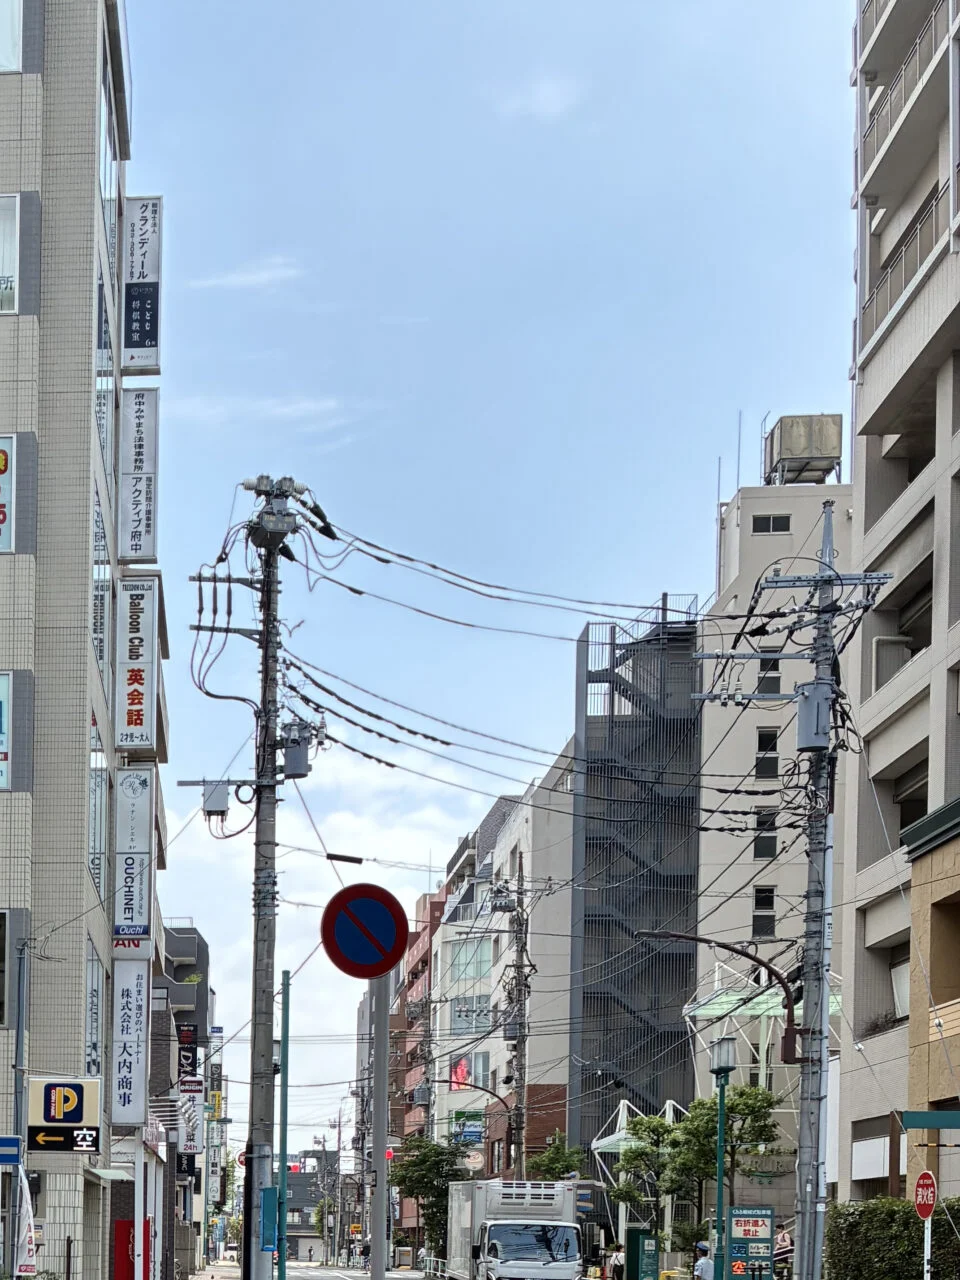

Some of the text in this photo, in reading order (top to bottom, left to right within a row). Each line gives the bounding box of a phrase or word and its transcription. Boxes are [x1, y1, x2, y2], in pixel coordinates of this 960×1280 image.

[137, 202, 149, 280] グランディール
[145, 300, 153, 330] こども
[133, 393, 145, 472] 府中みやまち法律事務所
[130, 476, 143, 554] アクティブ府中
[128, 593, 145, 660] Balloon Club
[126, 667, 145, 727] 英会話
[123, 856, 135, 923] OUCHINET
[117, 988, 133, 1107] 株式会社 大内商事
[134, 973, 143, 1064] お住まい選びのパートナー
[73, 1127, 96, 1151] 空
[735, 1219, 768, 1228] 右折進入
[916, 1187, 935, 1204] 消火栓
[742, 1229, 760, 1237] 禁止
[731, 1260, 747, 1275] 空
